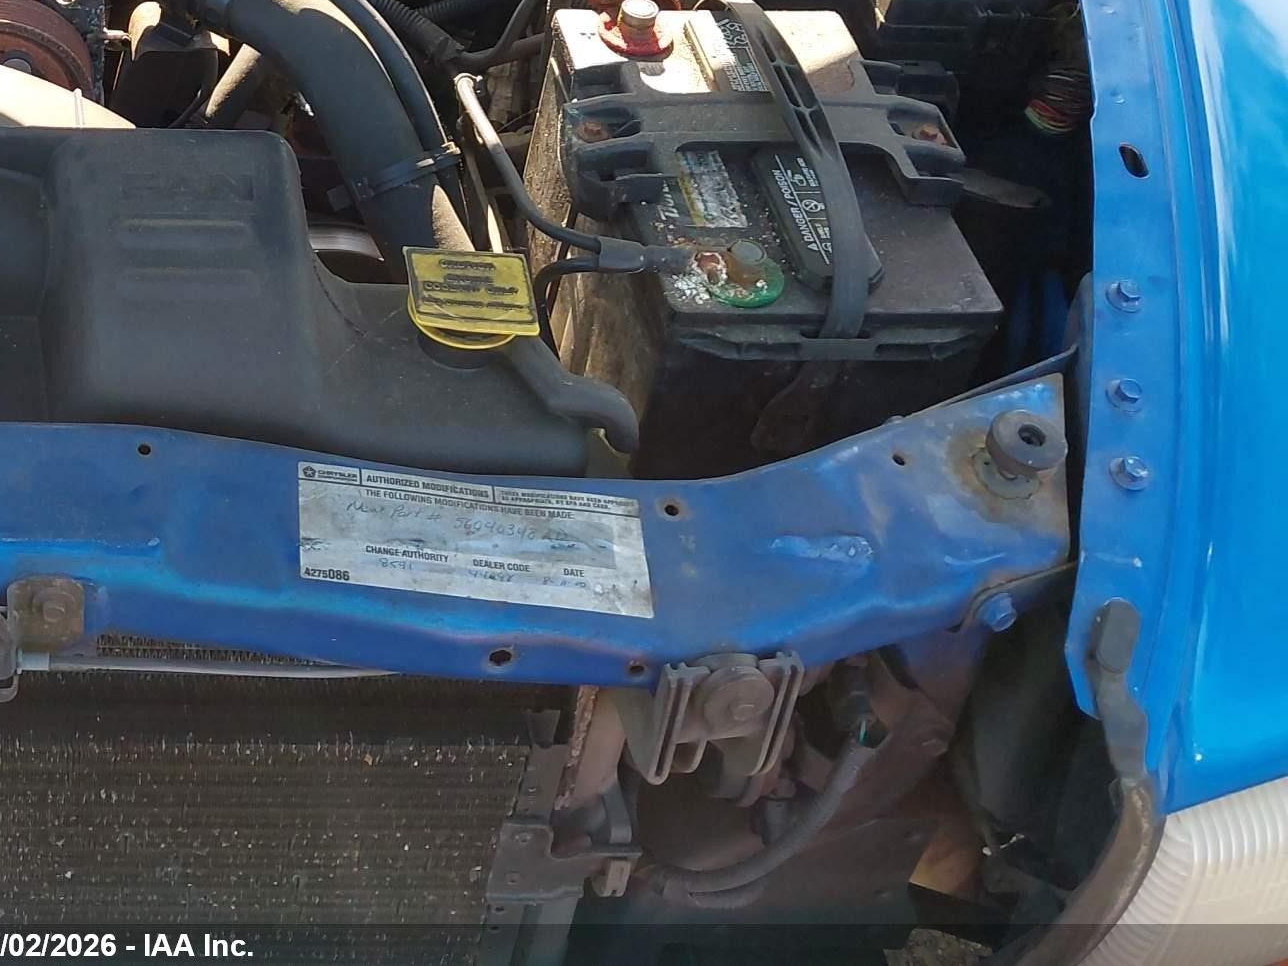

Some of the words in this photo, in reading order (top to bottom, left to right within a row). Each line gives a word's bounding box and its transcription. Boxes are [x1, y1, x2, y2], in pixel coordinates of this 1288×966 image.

[790, 207, 815, 242] DANGER
[317, 469, 358, 478] CHRYSLER
[366, 474, 420, 489] AUTHORIZED
[422, 482, 490, 498] MODIFICATIONS
[365, 489, 382, 499] THE
[383, 490, 433, 505] FOLLOWING
[434, 497, 500, 514] MODIFICATIONS
[500, 505, 523, 516] HAVE
[524, 508, 547, 518] BEEN
[365, 545, 400, 557] CHANGE
[401, 550, 449, 563] AUTHORITY
[472, 559, 506, 571] DEALER
[507, 562, 531, 573] CODE
[563, 568, 585, 578] DATE
